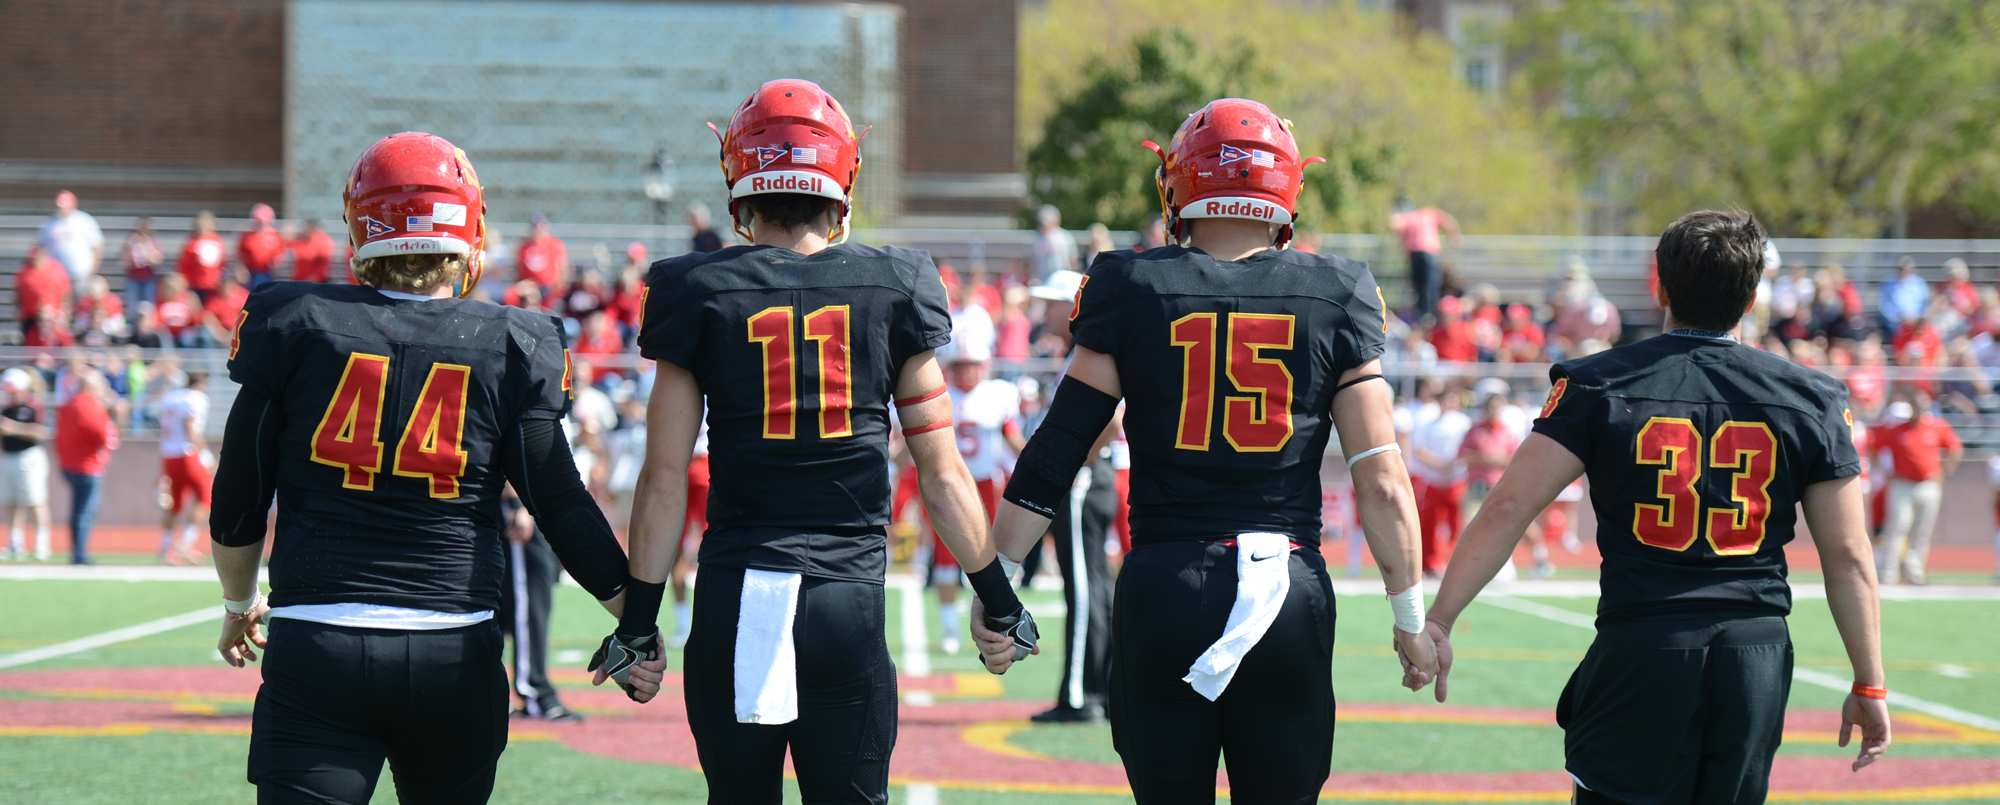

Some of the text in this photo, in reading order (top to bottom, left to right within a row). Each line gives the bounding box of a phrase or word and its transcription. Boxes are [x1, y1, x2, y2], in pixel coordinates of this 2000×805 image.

[752, 175, 823, 193] Riddell
[1206, 201, 1275, 220] Riddell
[310, 351, 472, 499] 44
[746, 303, 853, 440] 11
[1170, 312, 1296, 453] 15
[1632, 416, 1778, 557] 33
